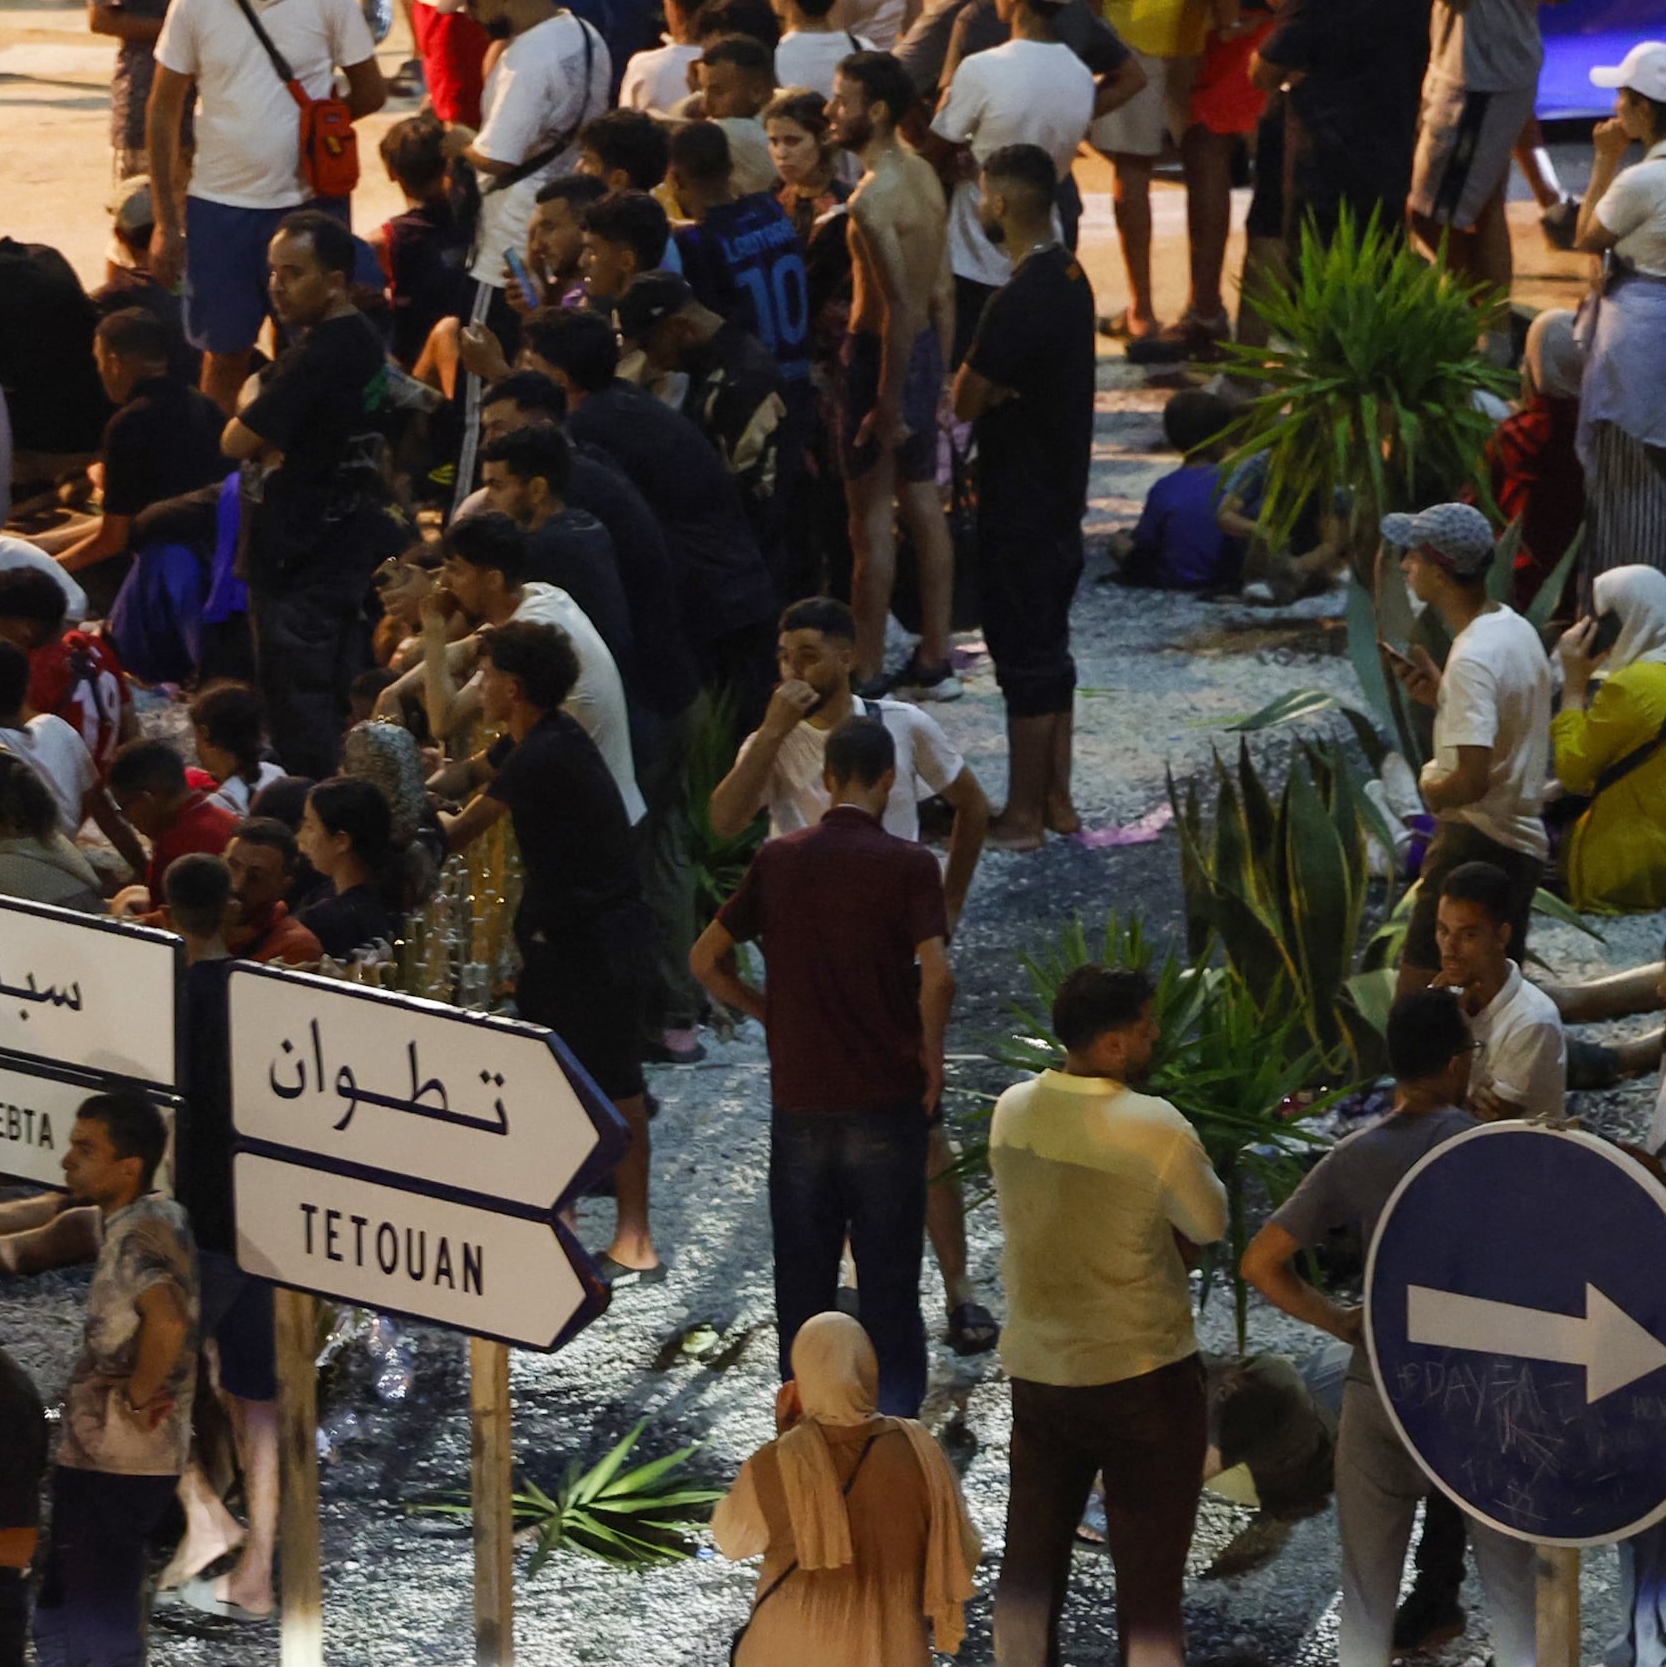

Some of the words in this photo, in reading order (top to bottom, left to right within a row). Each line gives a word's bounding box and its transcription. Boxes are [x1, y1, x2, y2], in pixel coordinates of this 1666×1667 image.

[735, 253, 809, 354] 10
[270, 1019, 508, 1135] تطوان
[300, 1203, 482, 1295] TETOUAN
